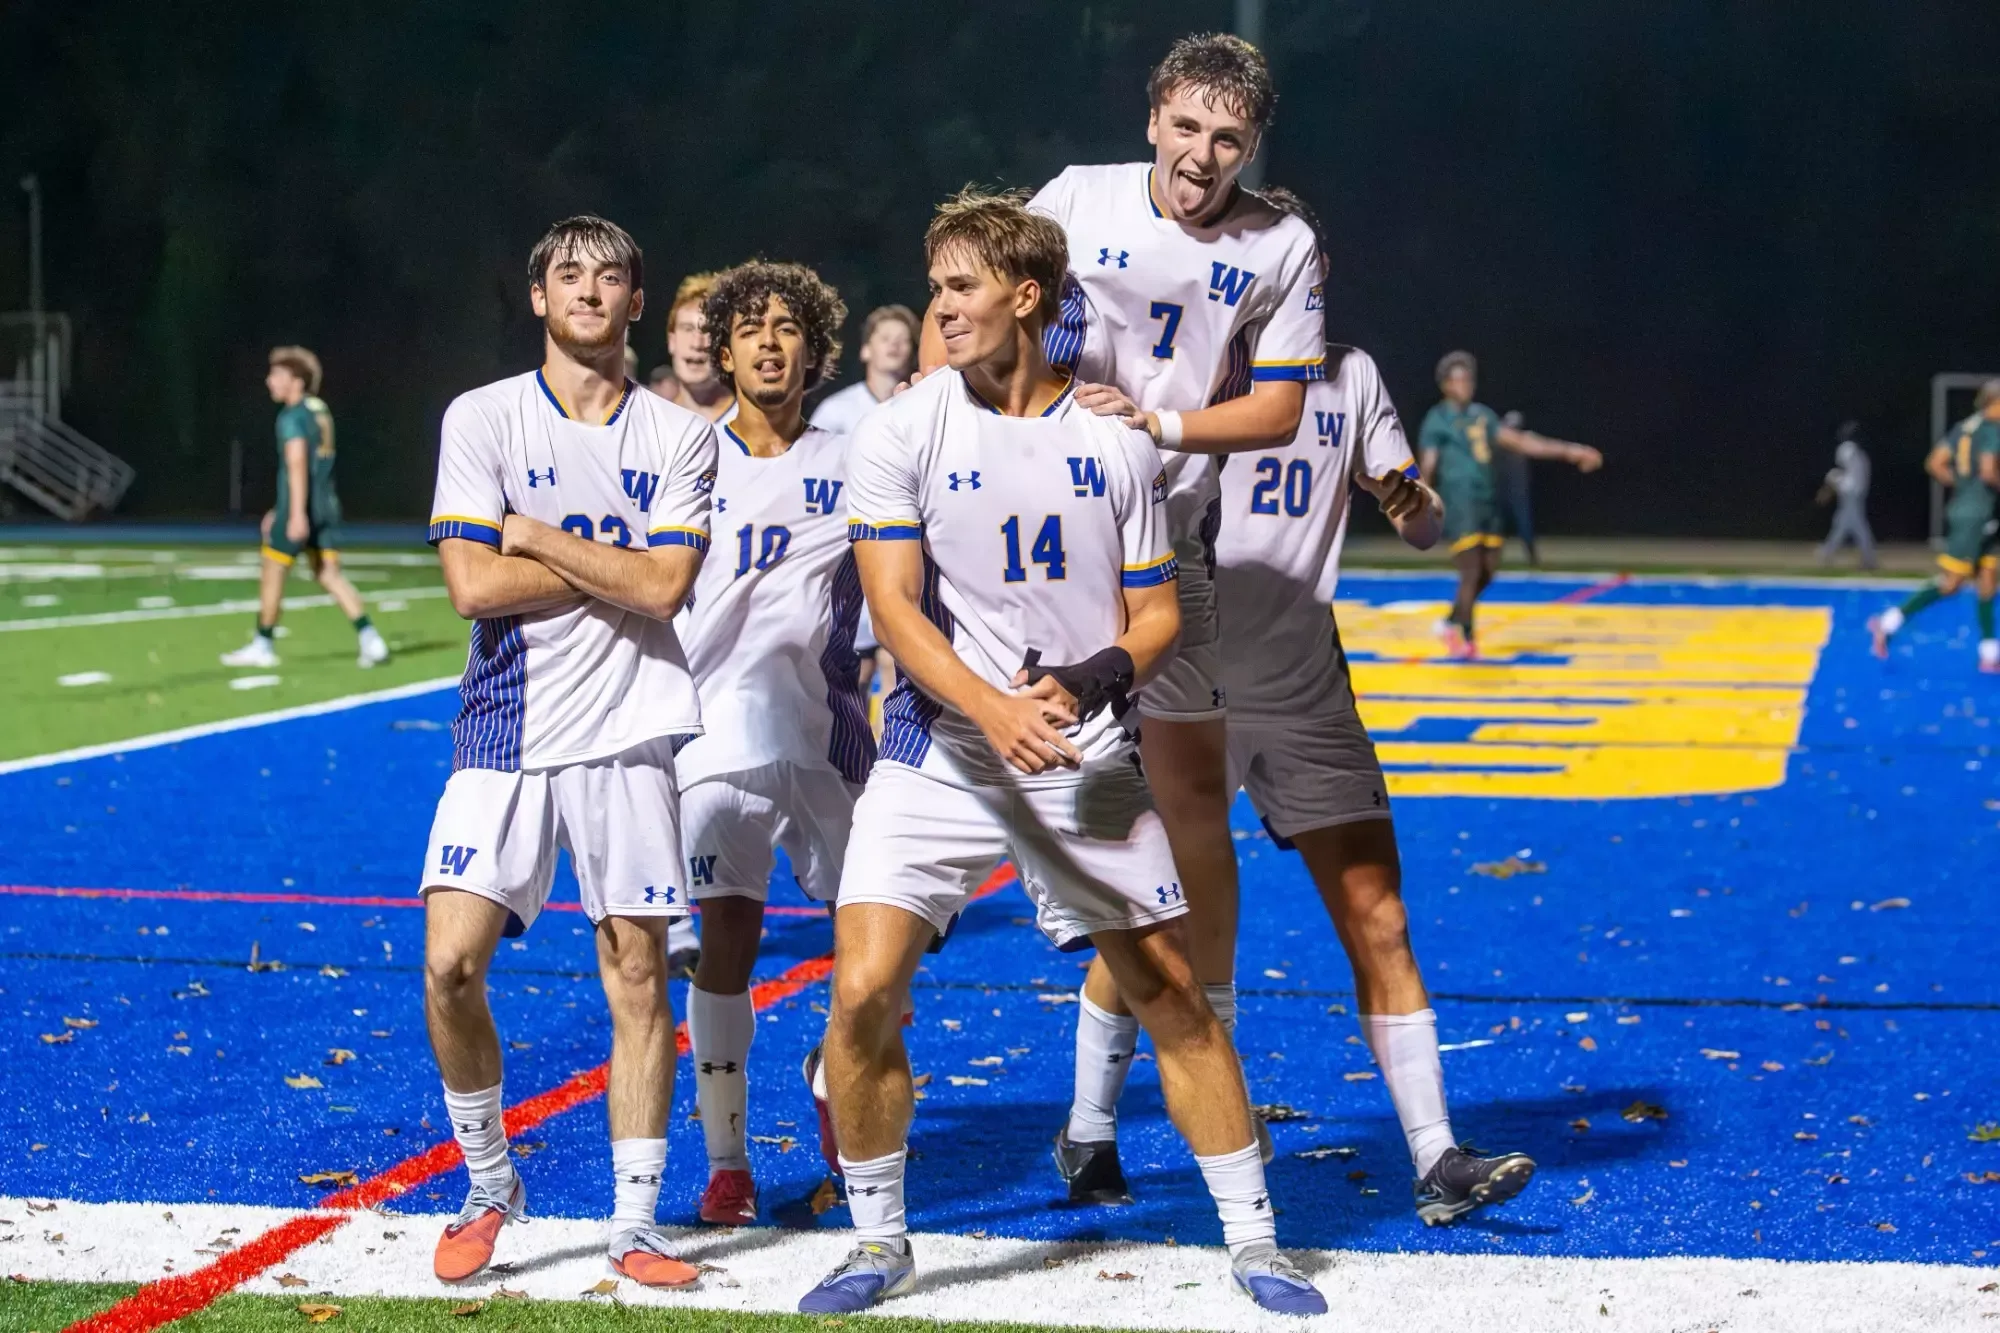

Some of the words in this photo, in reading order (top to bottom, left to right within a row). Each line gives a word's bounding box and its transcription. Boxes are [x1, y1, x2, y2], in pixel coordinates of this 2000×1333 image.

[1208, 260, 1256, 307] W
[1150, 300, 1185, 361] 7
[1314, 410, 1346, 448] W
[802, 477, 844, 515] W
[1251, 455, 1313, 518] 20
[1000, 513, 1066, 583] 14
[439, 844, 478, 876] W
[689, 855, 717, 887] W
